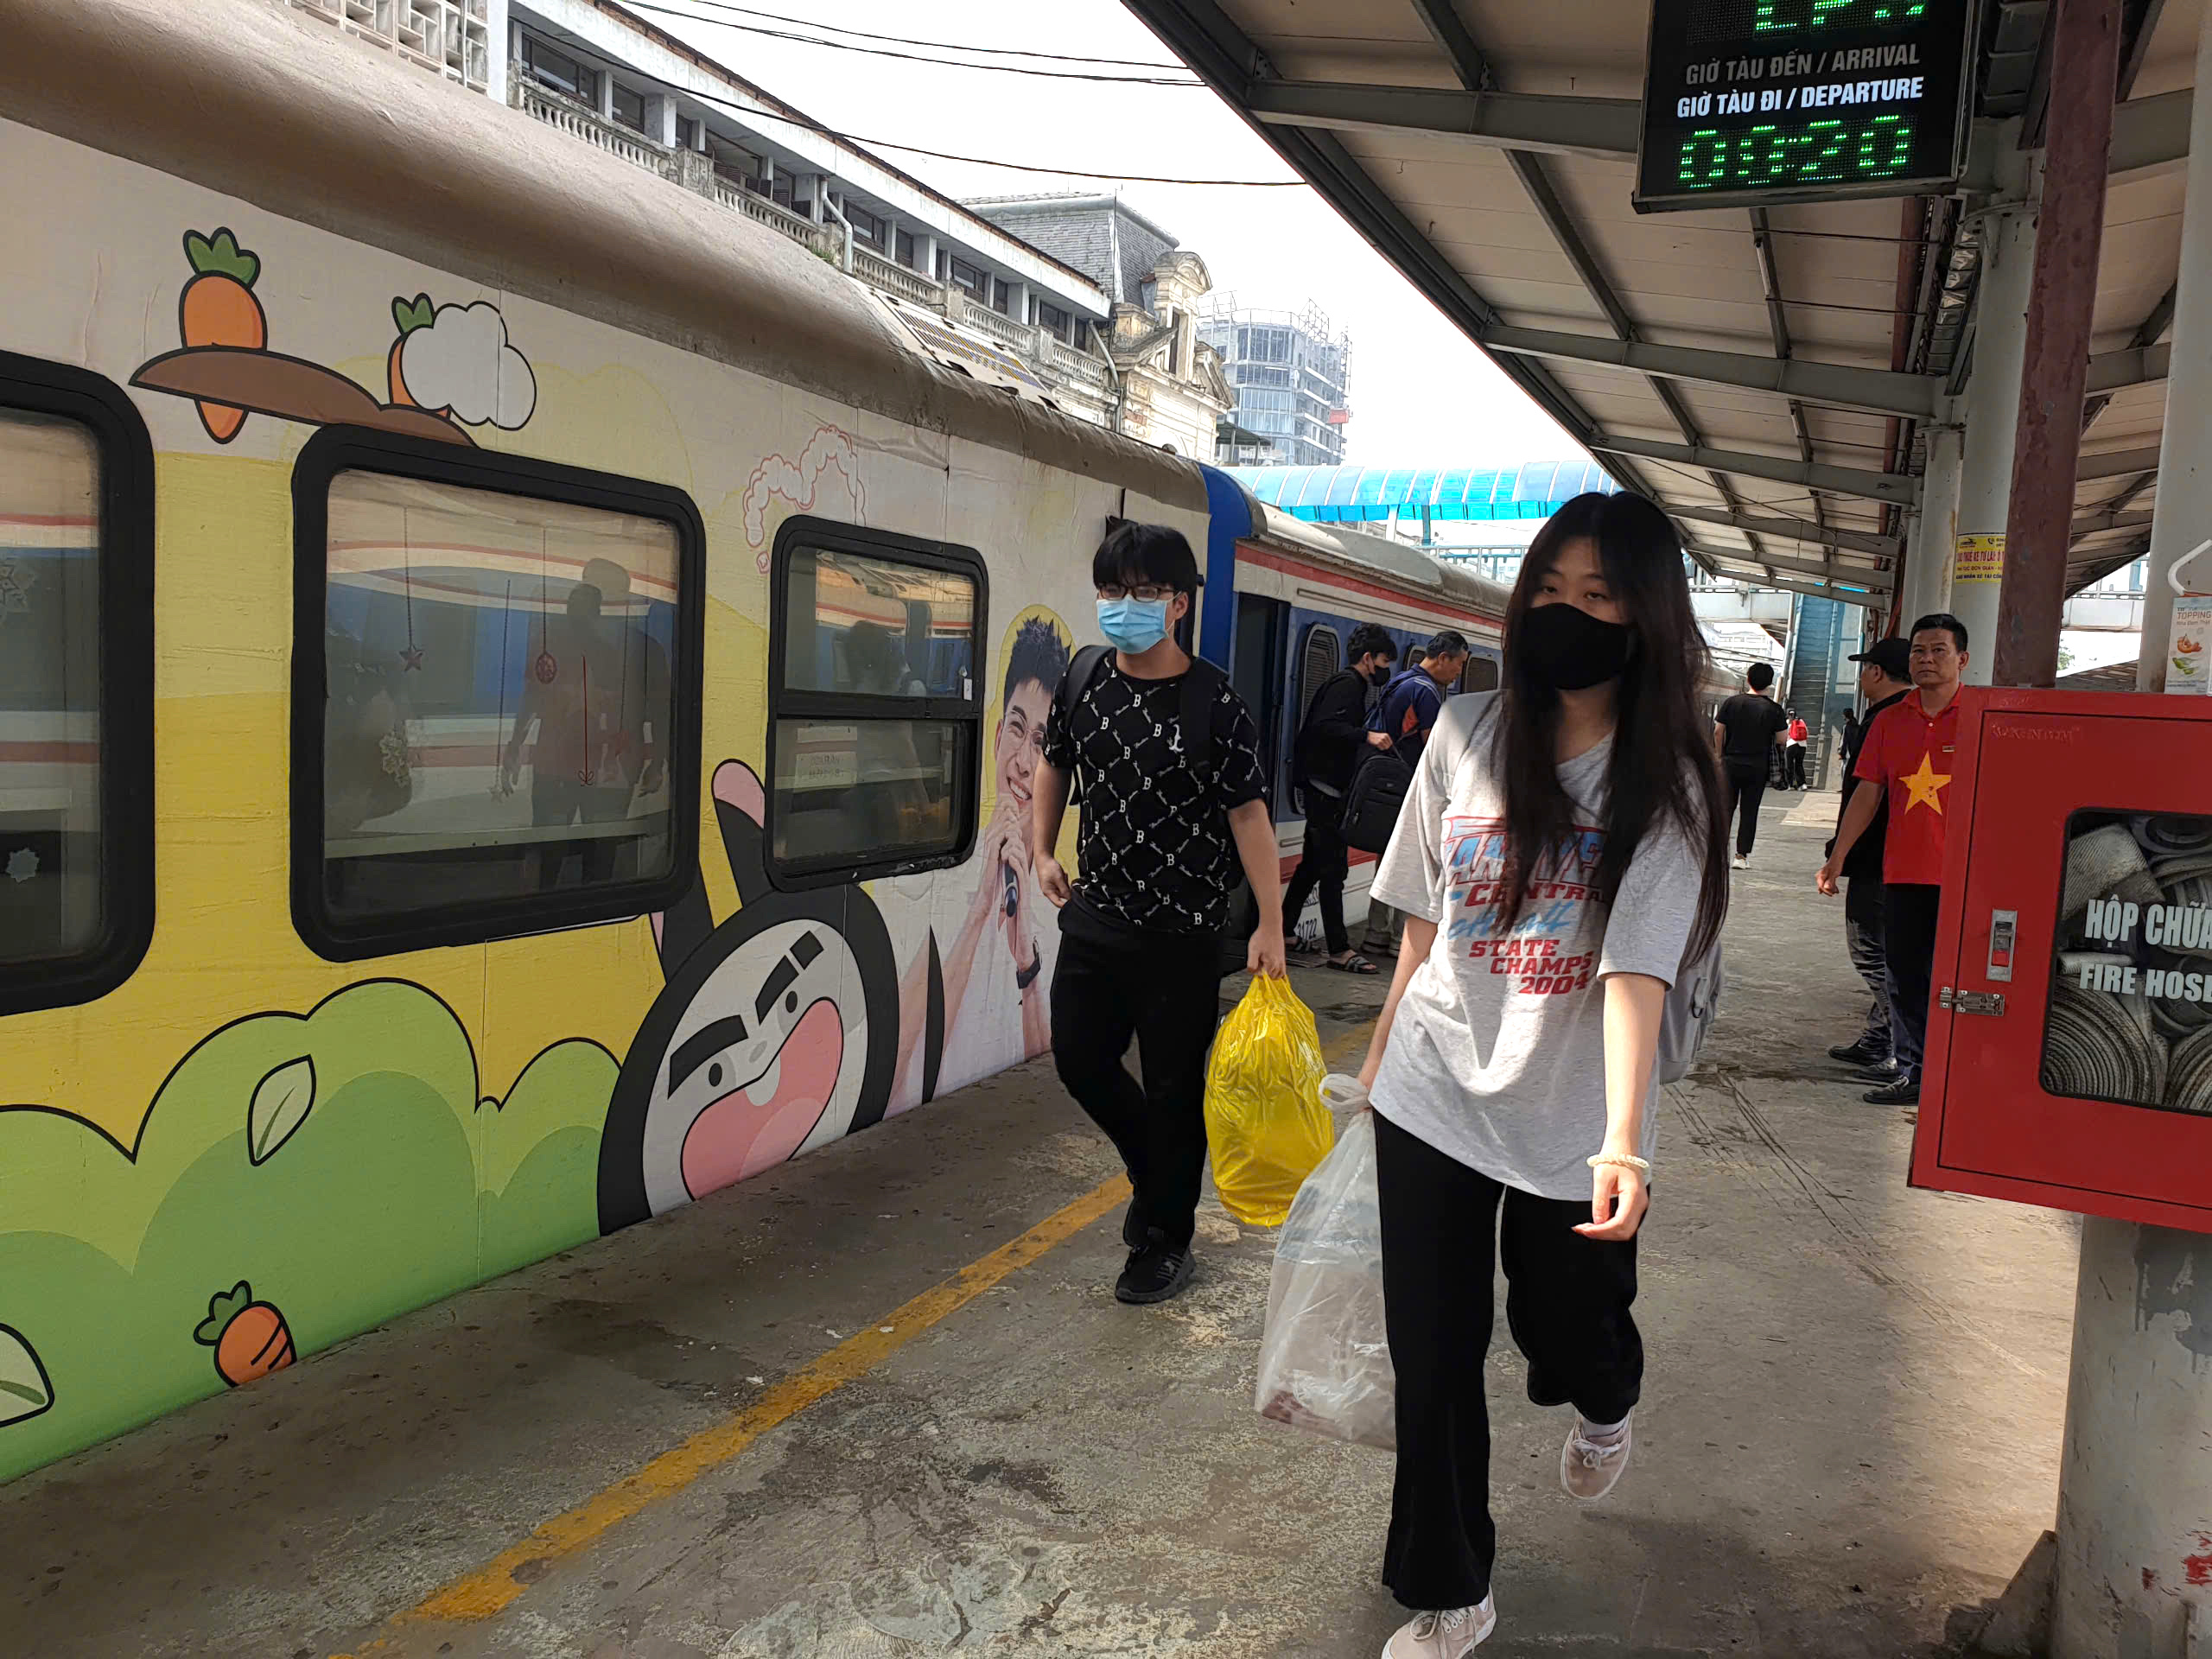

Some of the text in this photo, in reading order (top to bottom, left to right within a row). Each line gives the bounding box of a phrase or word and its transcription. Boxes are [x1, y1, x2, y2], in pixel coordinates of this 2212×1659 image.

[1686, 57, 1719, 85] GIỜ
[1726, 56, 1764, 80] TÀU
[1770, 48, 1813, 77] ĐẾN
[1831, 43, 1920, 72] ARRIVAL
[1677, 91, 1712, 118] GIỜ
[1717, 89, 1755, 114] TÀU
[1760, 89, 1782, 111] ĐI
[1801, 76, 1924, 108] DEPARTURE
[2084, 893, 2212, 950] HỘP CHỮA
[1469, 939, 1560, 957] STATE
[1491, 950, 1595, 975] CHAMPS
[1517, 970, 1590, 995] 2004
[2079, 963, 2138, 995] FIRE
